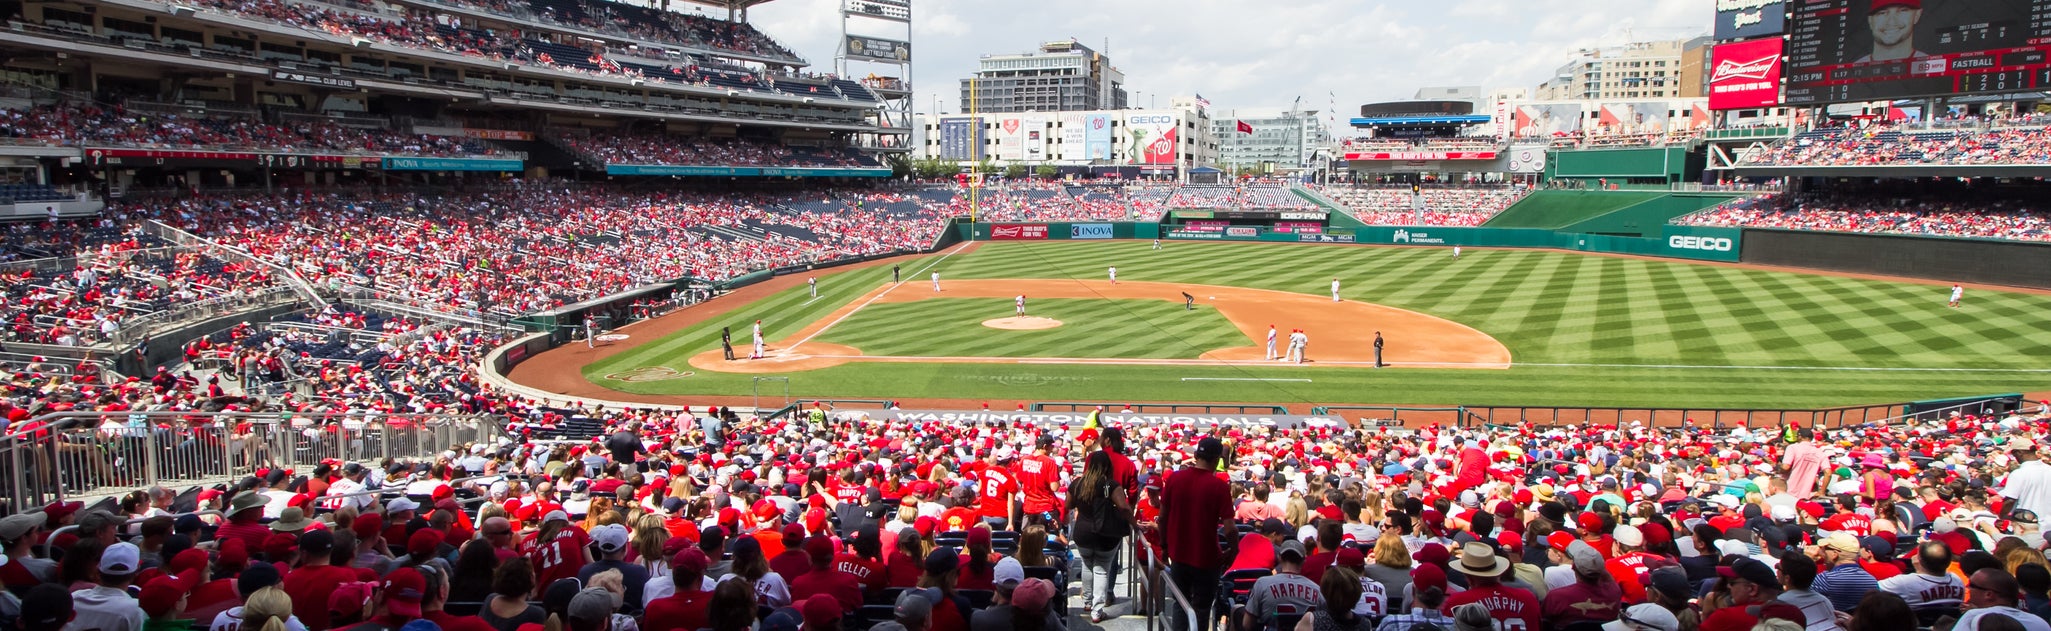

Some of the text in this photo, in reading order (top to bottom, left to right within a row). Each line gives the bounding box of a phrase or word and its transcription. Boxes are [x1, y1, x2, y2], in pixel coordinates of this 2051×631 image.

[1734, 10, 1761, 29] Post
[1952, 58, 1993, 69] FASTBALL
[1716, 64, 1772, 76] Budweiser
[1793, 72, 1823, 82] 2:15 PM
[1982, 74, 1987, 82] 2
[1999, 72, 2006, 80] 0
[2018, 72, 2022, 80] 1
[338, 79, 352, 87] LEVEL
[1714, 81, 1772, 93] THIS BUD'S FOR YOU.
[1842, 92, 1848, 100] 0
[1980, 83, 1986, 91] 2
[1998, 82, 2004, 90] 0
[2018, 80, 2021, 88] 1
[1130, 116, 1170, 124] GEICO
[394, 160, 418, 168] INOVA
[1082, 226, 1112, 235] INOVA
[1669, 235, 1732, 251] GEICO
[812, 412, 822, 420] 42
[897, 412, 1277, 426] WASHINGTON NATIONALS
[838, 489, 861, 497] HARPER
[986, 479, 998, 498] 6
[1842, 519, 1868, 530] HARPER
[838, 561, 871, 578] KELLEY
[1270, 582, 1319, 602] HARPER
[1920, 586, 1964, 601] HARPER
